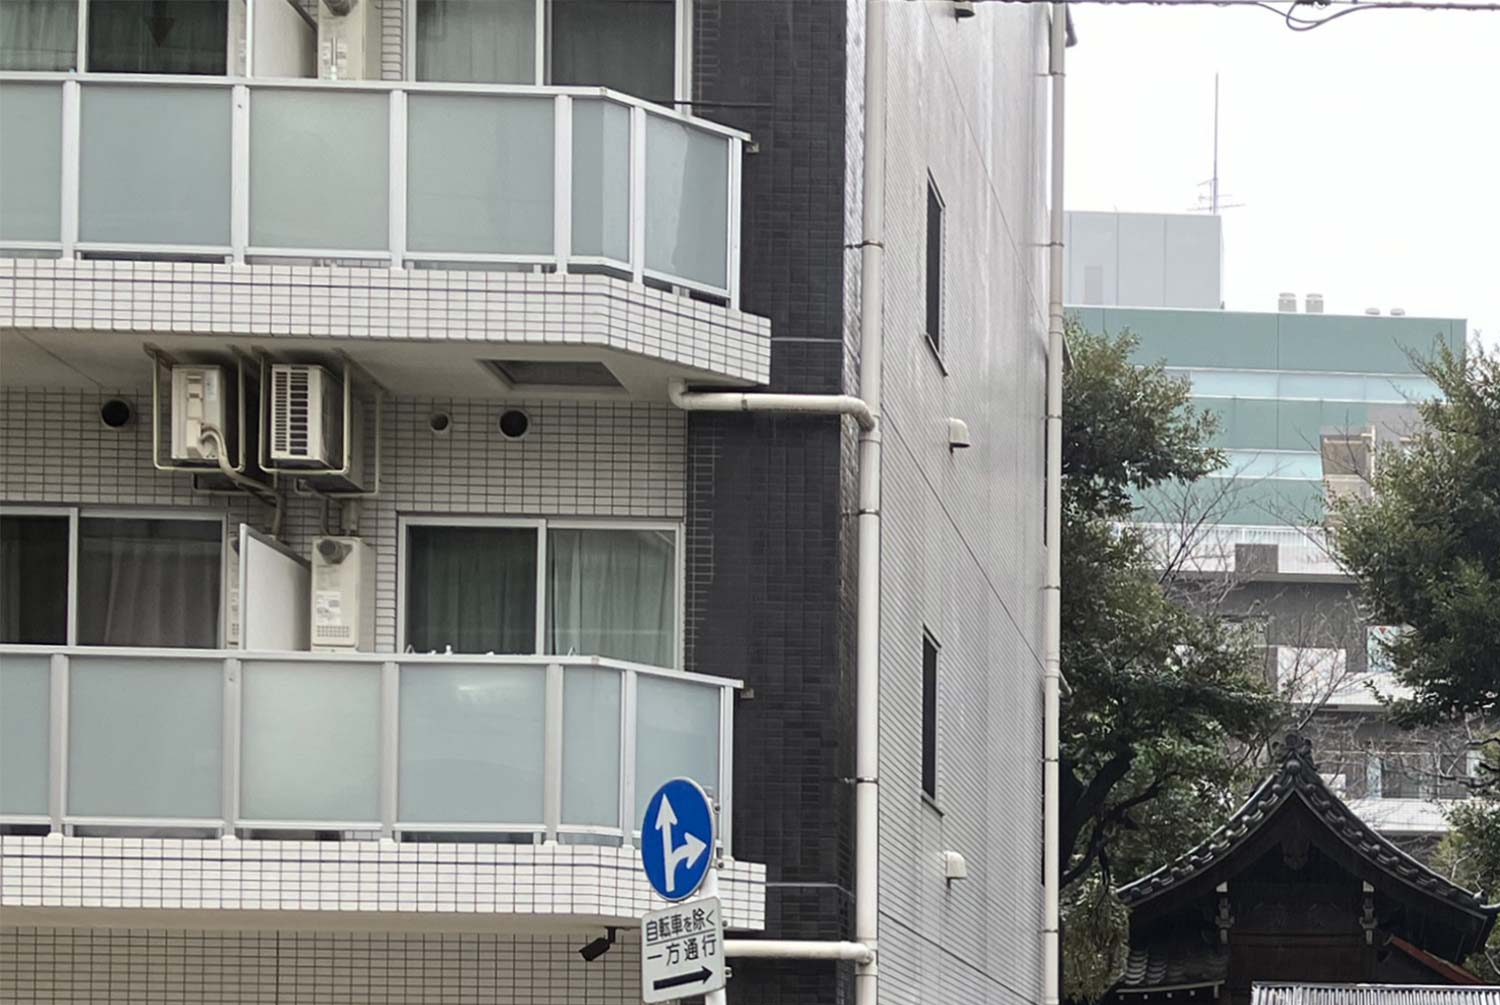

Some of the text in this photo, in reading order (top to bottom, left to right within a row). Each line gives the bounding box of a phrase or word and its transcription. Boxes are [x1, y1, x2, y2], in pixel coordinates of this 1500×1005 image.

[646, 908, 715, 941] 自転車を除く
[647, 934, 717, 966] 一方通行
